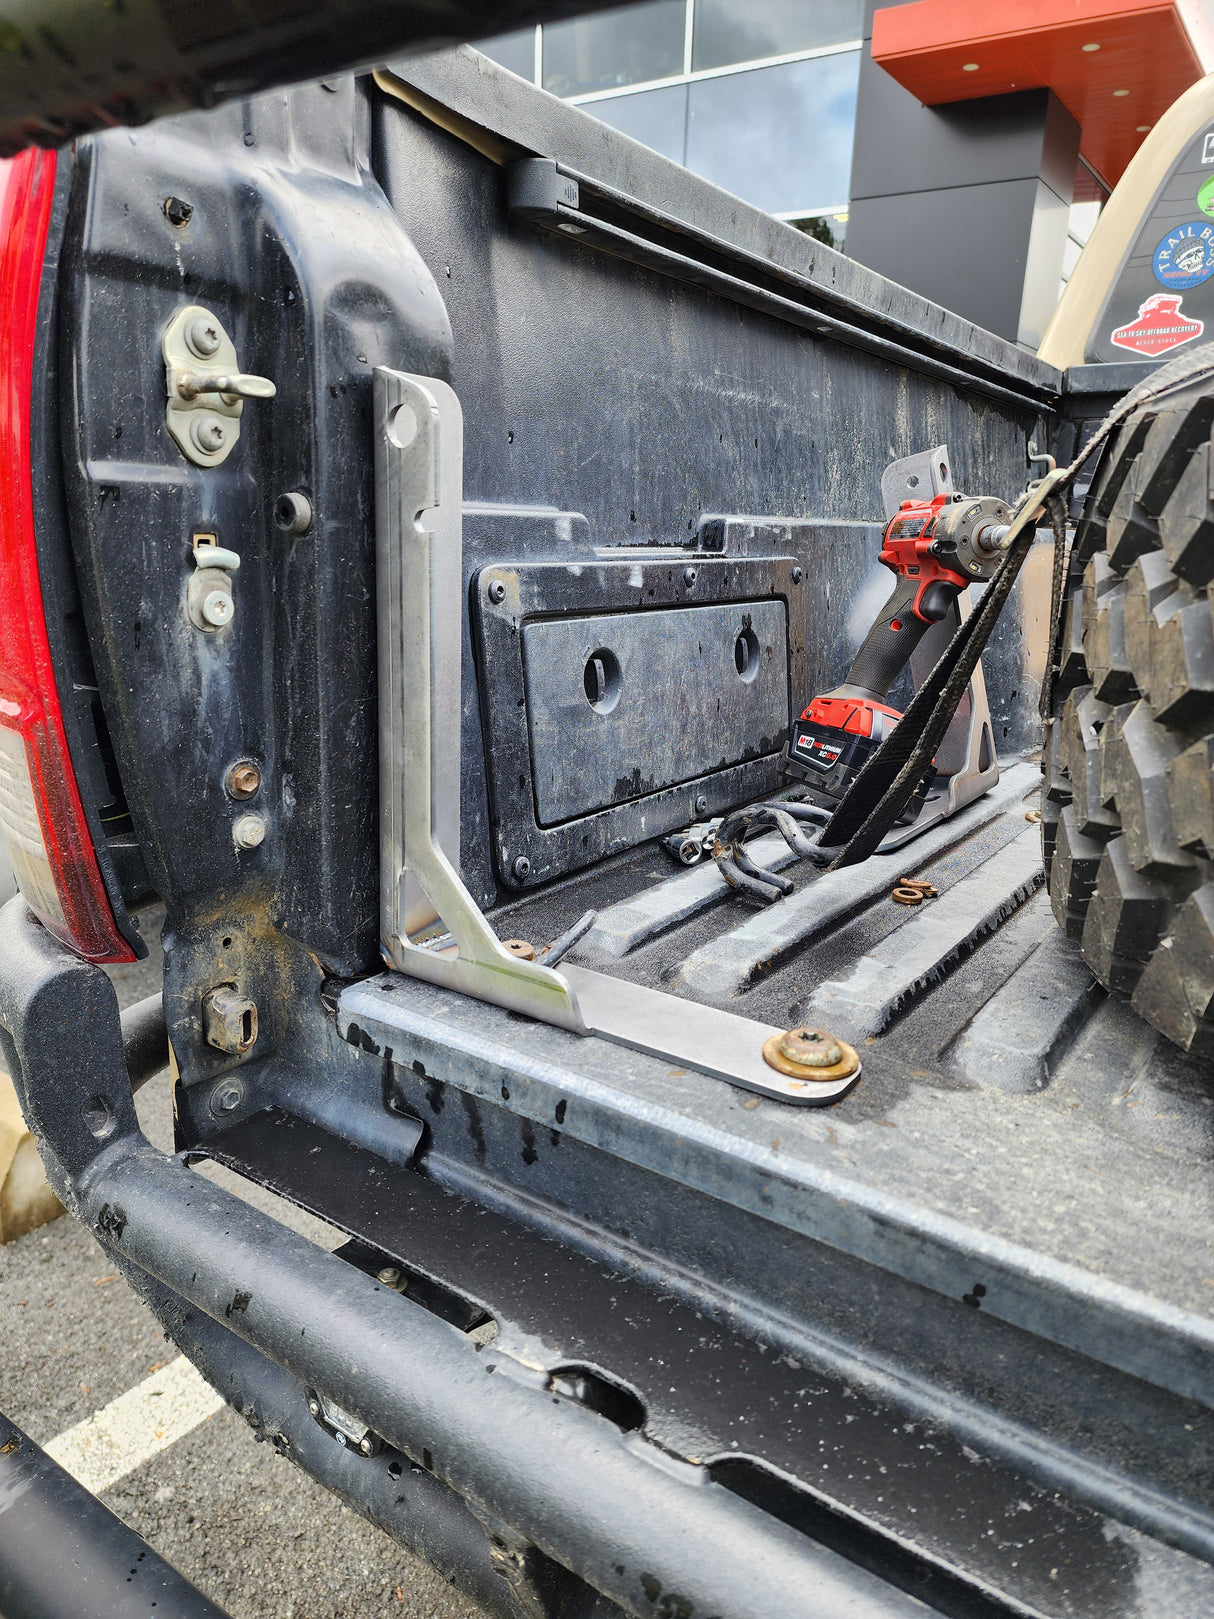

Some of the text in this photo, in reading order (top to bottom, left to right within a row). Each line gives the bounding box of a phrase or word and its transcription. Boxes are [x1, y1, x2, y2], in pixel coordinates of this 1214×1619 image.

[1159, 226, 1196, 273] TRAIL
[1116, 324, 1198, 339] SEA TO SKY OFFROAD RECOVERY
[798, 736, 842, 754] M18 REDLITHIUM
[818, 750, 837, 761] XC5.0
